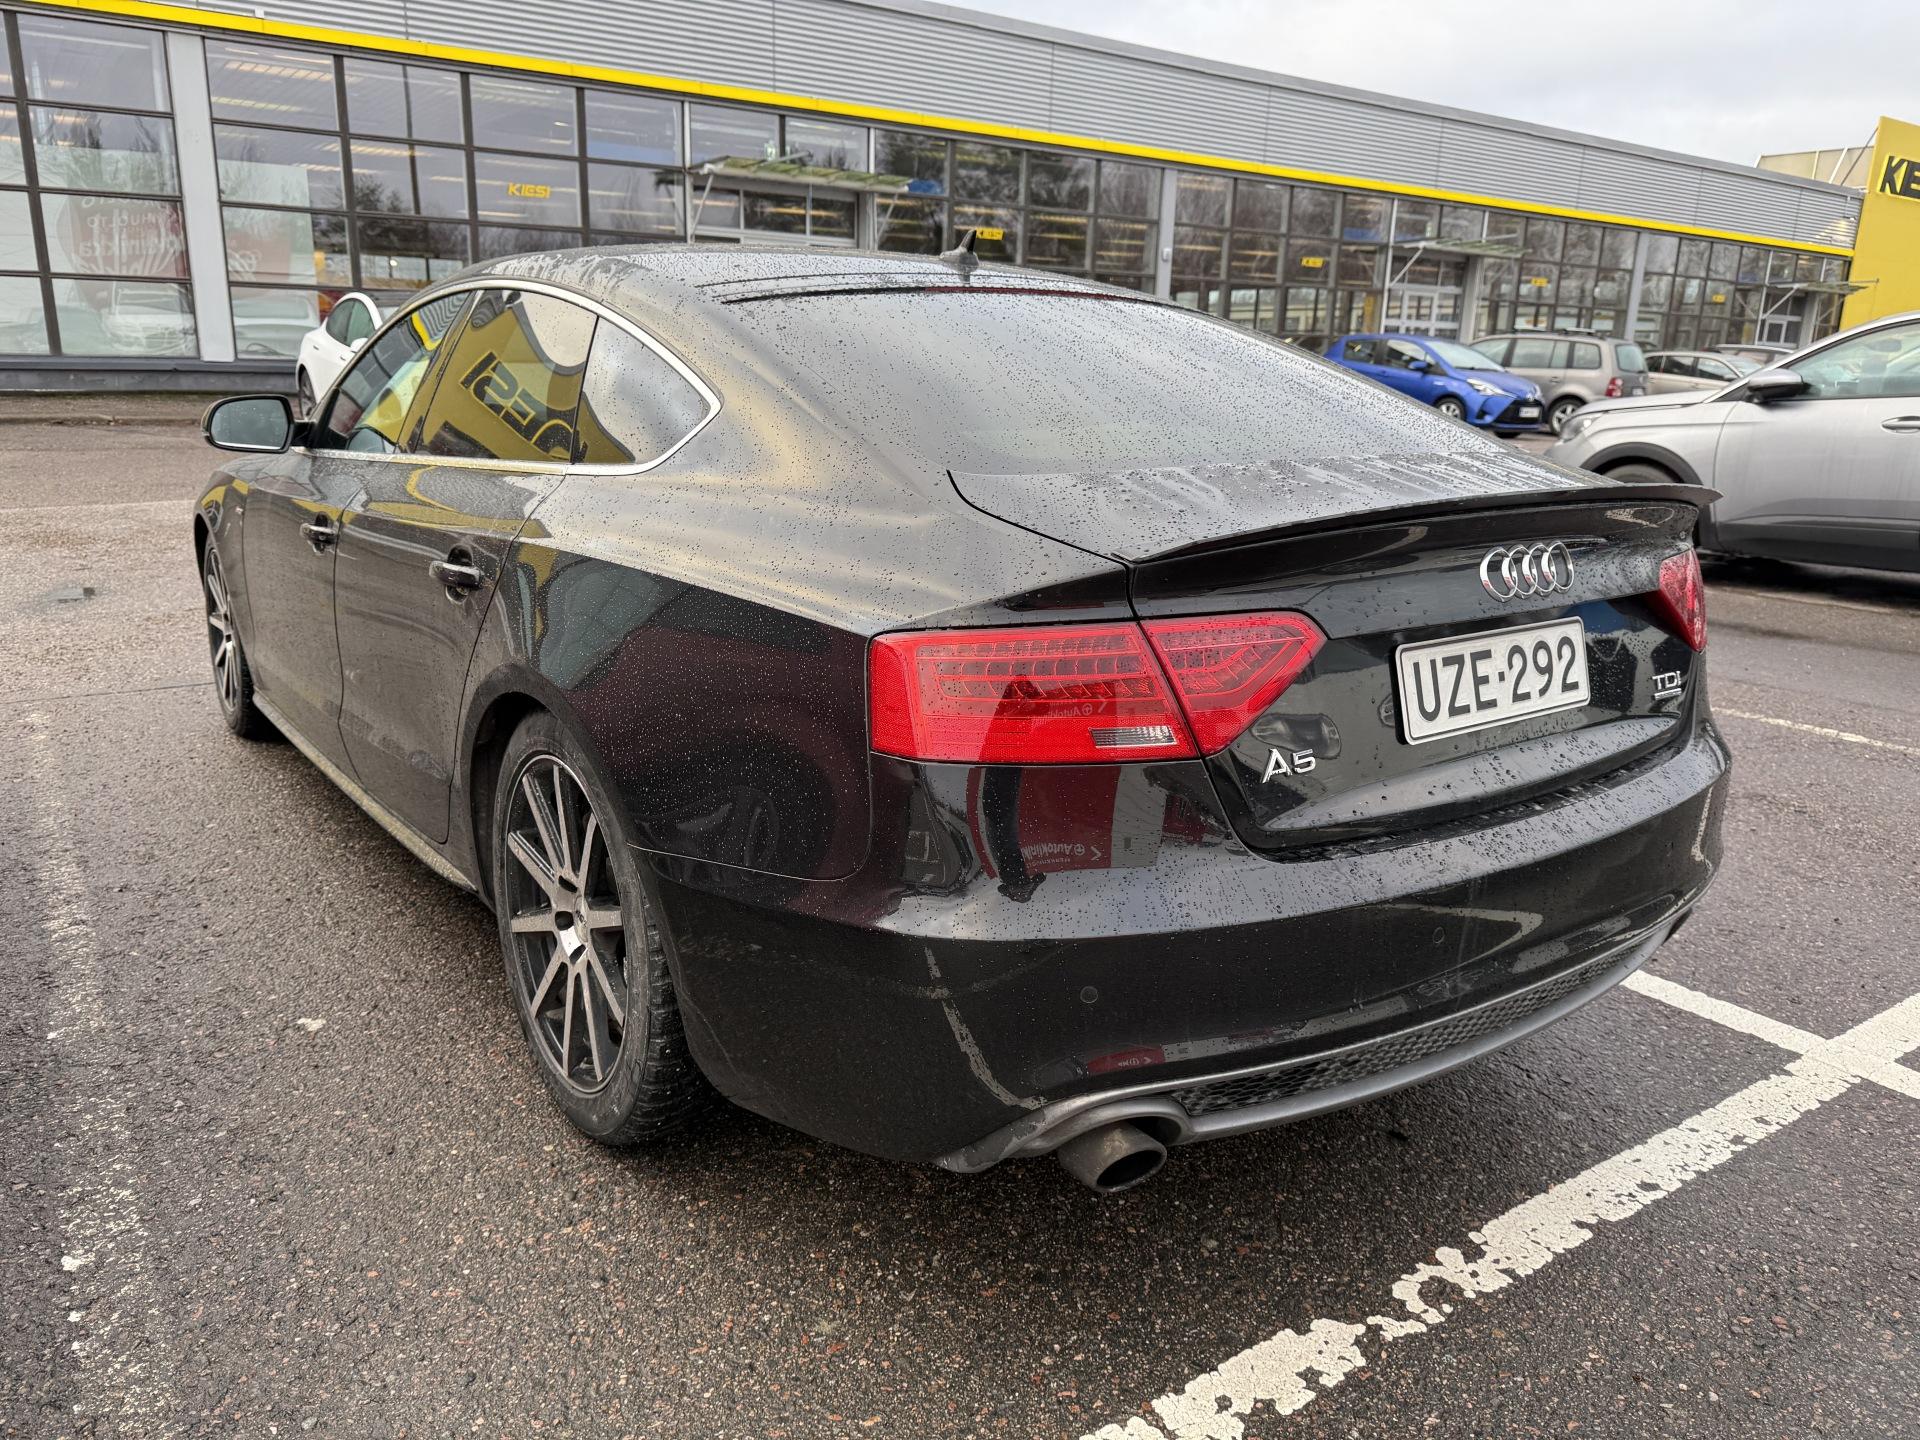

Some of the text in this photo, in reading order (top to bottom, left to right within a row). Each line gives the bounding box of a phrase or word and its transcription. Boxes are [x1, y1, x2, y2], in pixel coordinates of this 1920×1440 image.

[1413, 636, 1579, 722] UZE-292
[1652, 670, 1681, 690] TDI
[1262, 748, 1316, 784] A5
